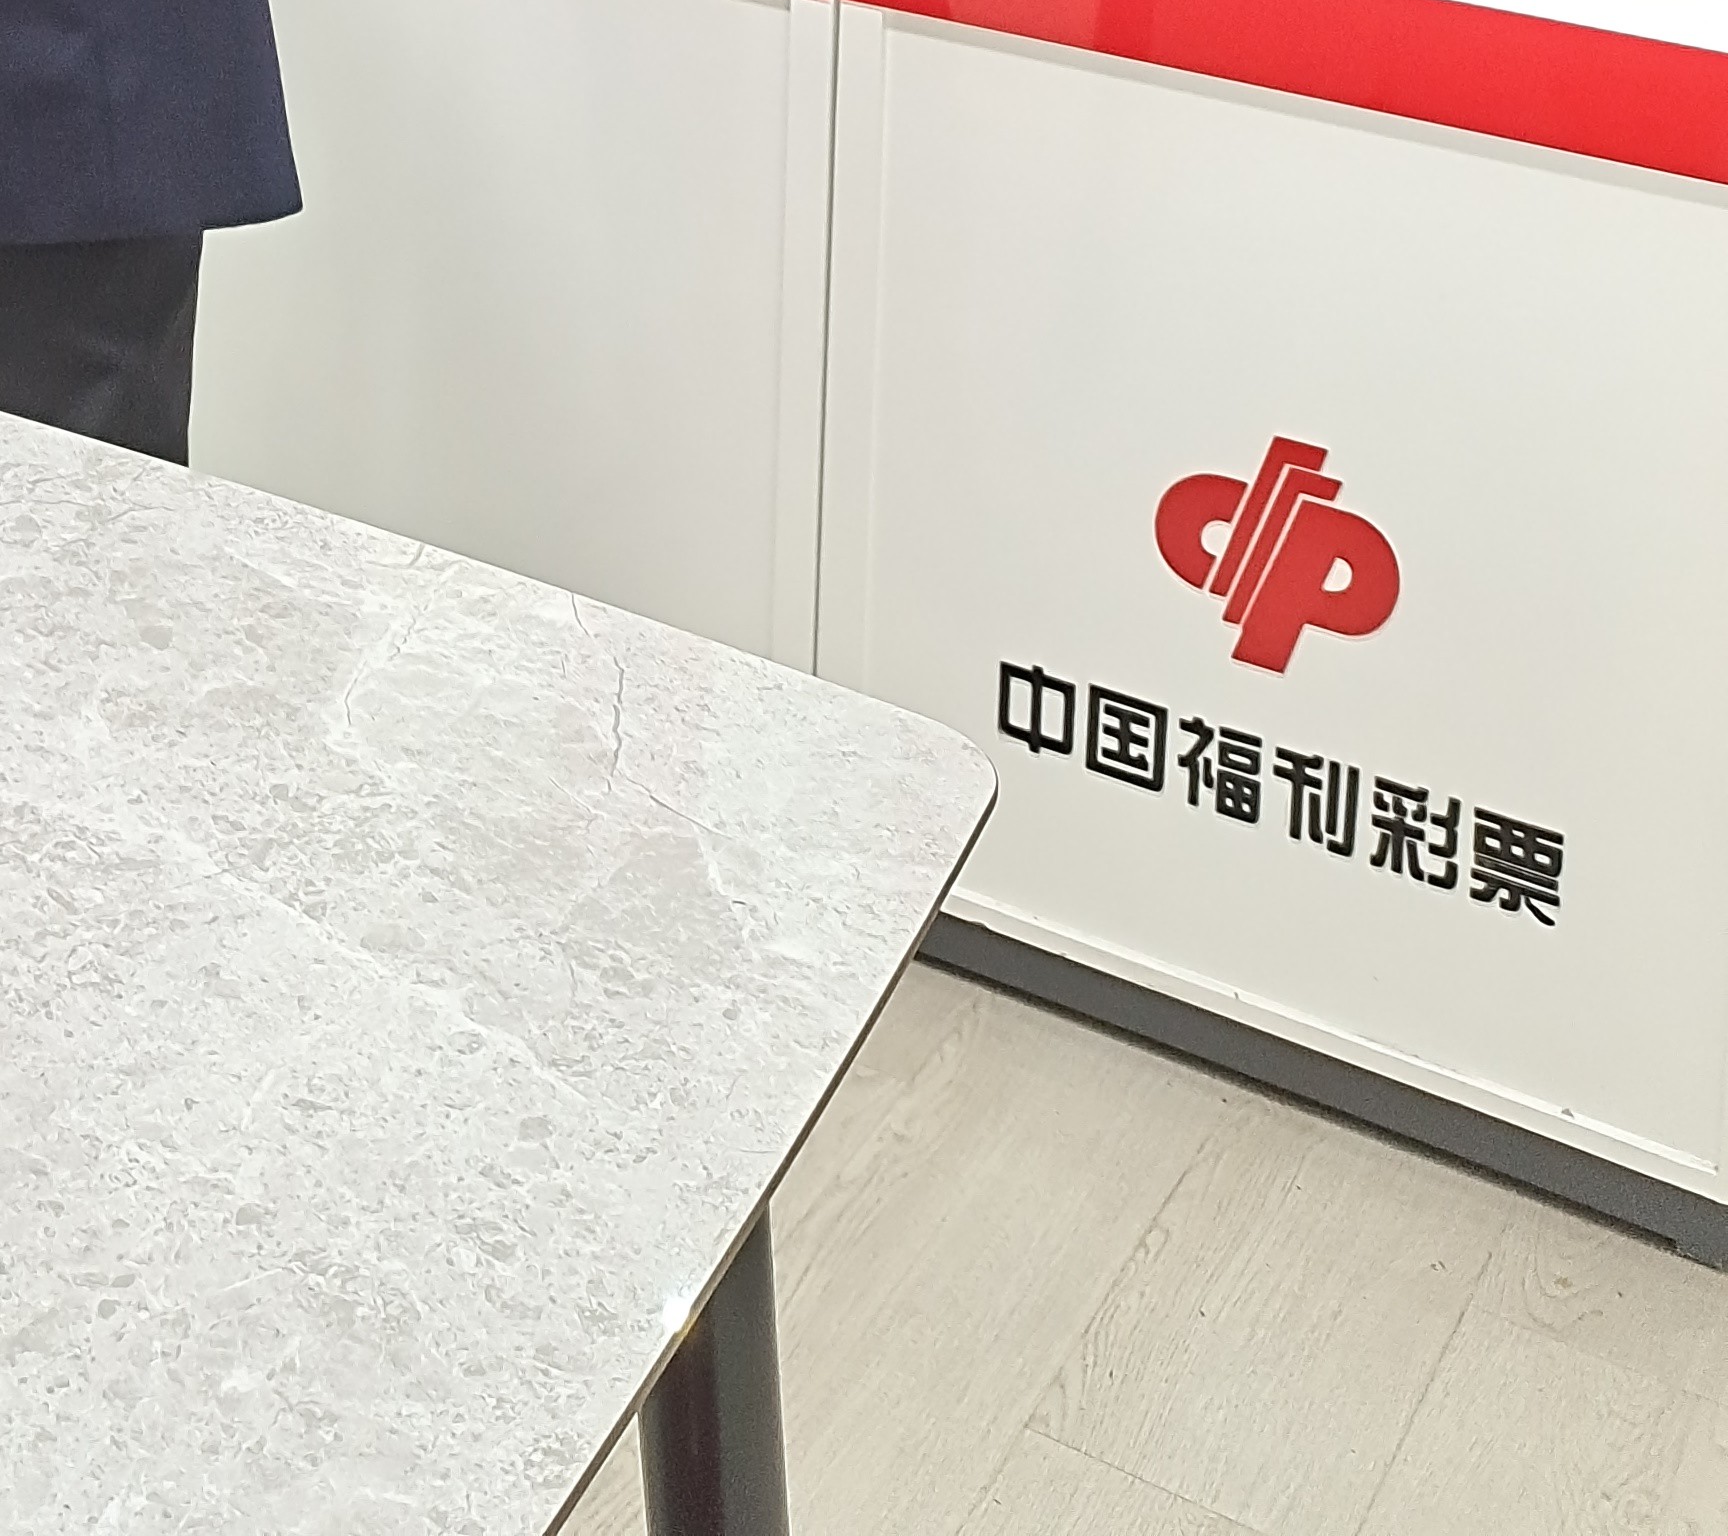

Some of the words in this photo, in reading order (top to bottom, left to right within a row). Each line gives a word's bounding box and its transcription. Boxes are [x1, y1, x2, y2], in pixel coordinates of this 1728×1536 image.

[998, 661, 1565, 927] 中国福利彩票
